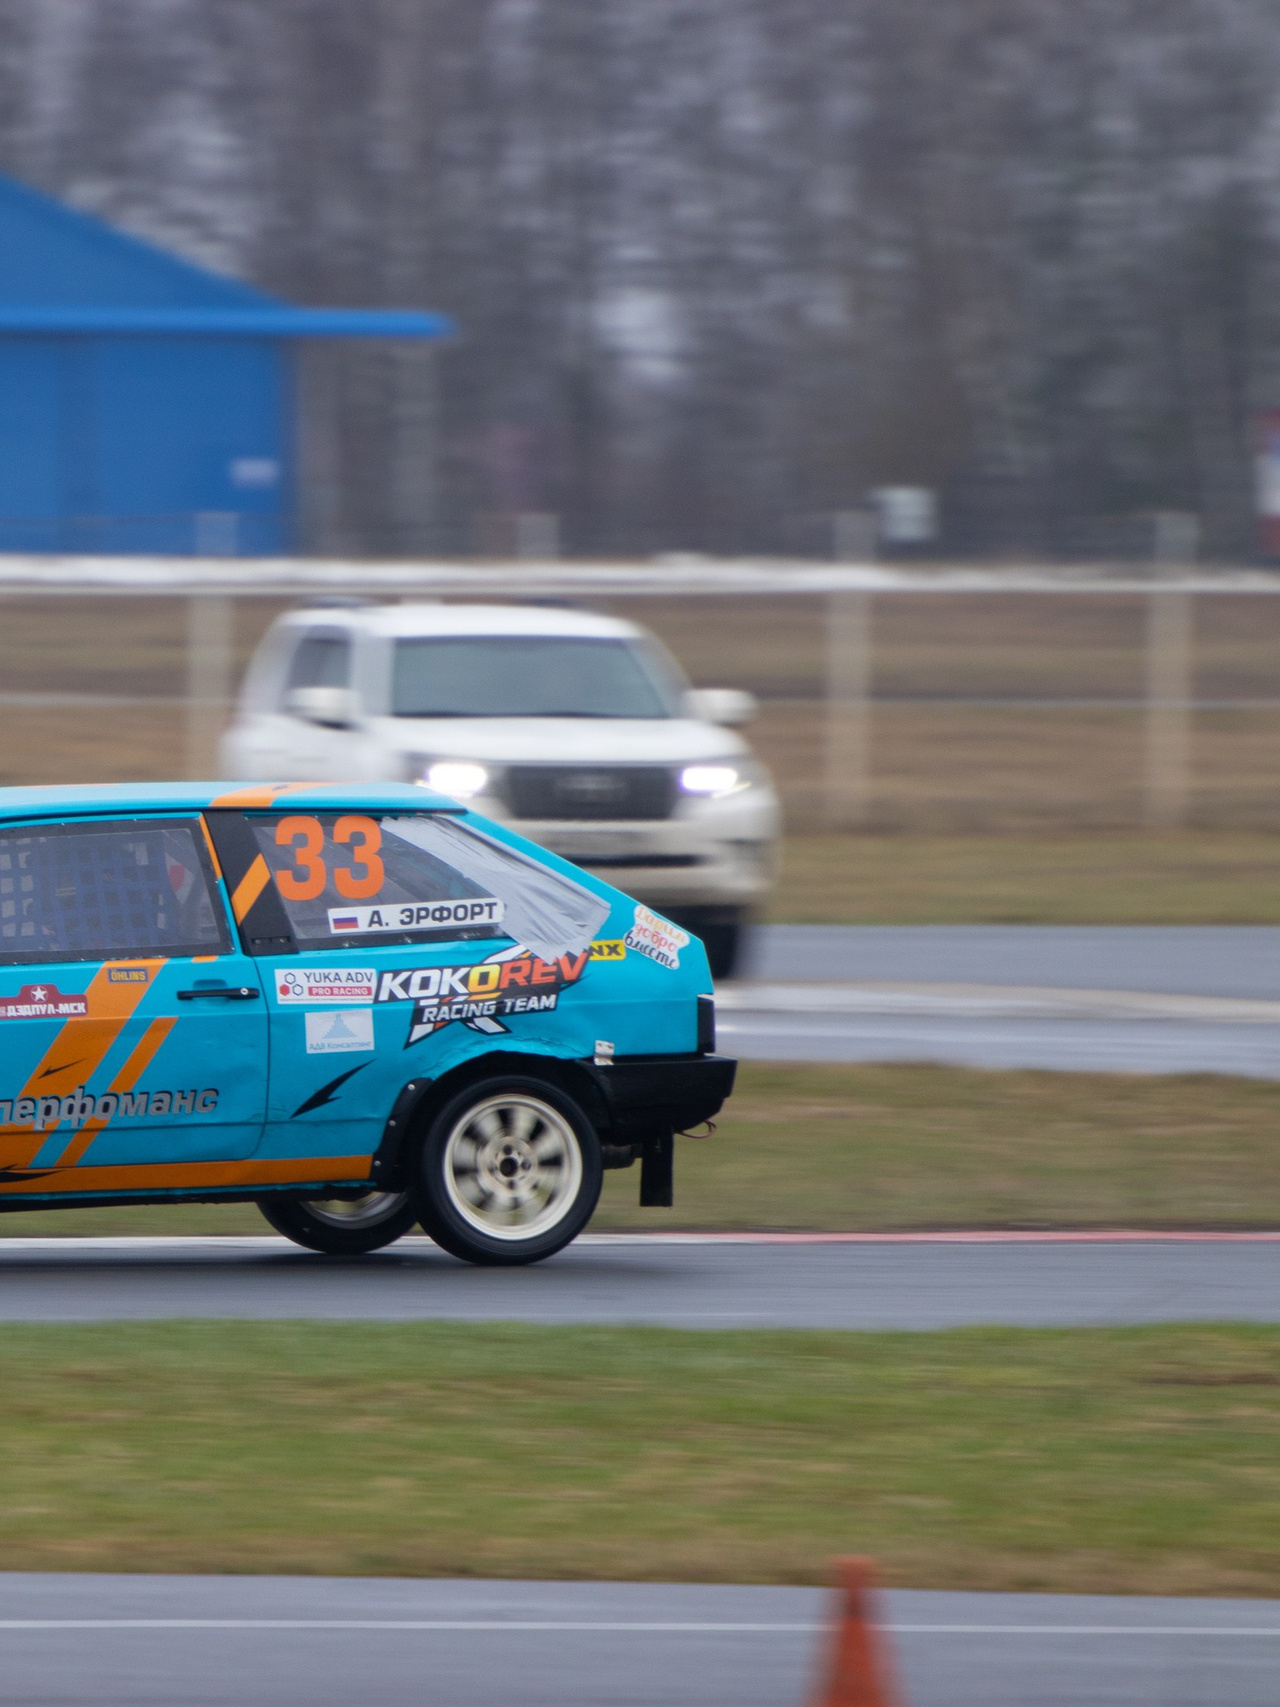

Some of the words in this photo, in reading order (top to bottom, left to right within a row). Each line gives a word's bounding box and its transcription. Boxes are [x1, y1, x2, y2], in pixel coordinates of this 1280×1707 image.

[275, 815, 384, 901] 33
[367, 910, 389, 928] А.
[399, 902, 497, 925] ЭРФОРТ
[304, 972, 342, 983] YUKA
[345, 972, 373, 982] ADV
[378, 951, 588, 1001] KOKOREV
[333, 987, 368, 995] RACING
[423, 1001, 496, 1022] RACING
[504, 994, 556, 1012] TEAM
